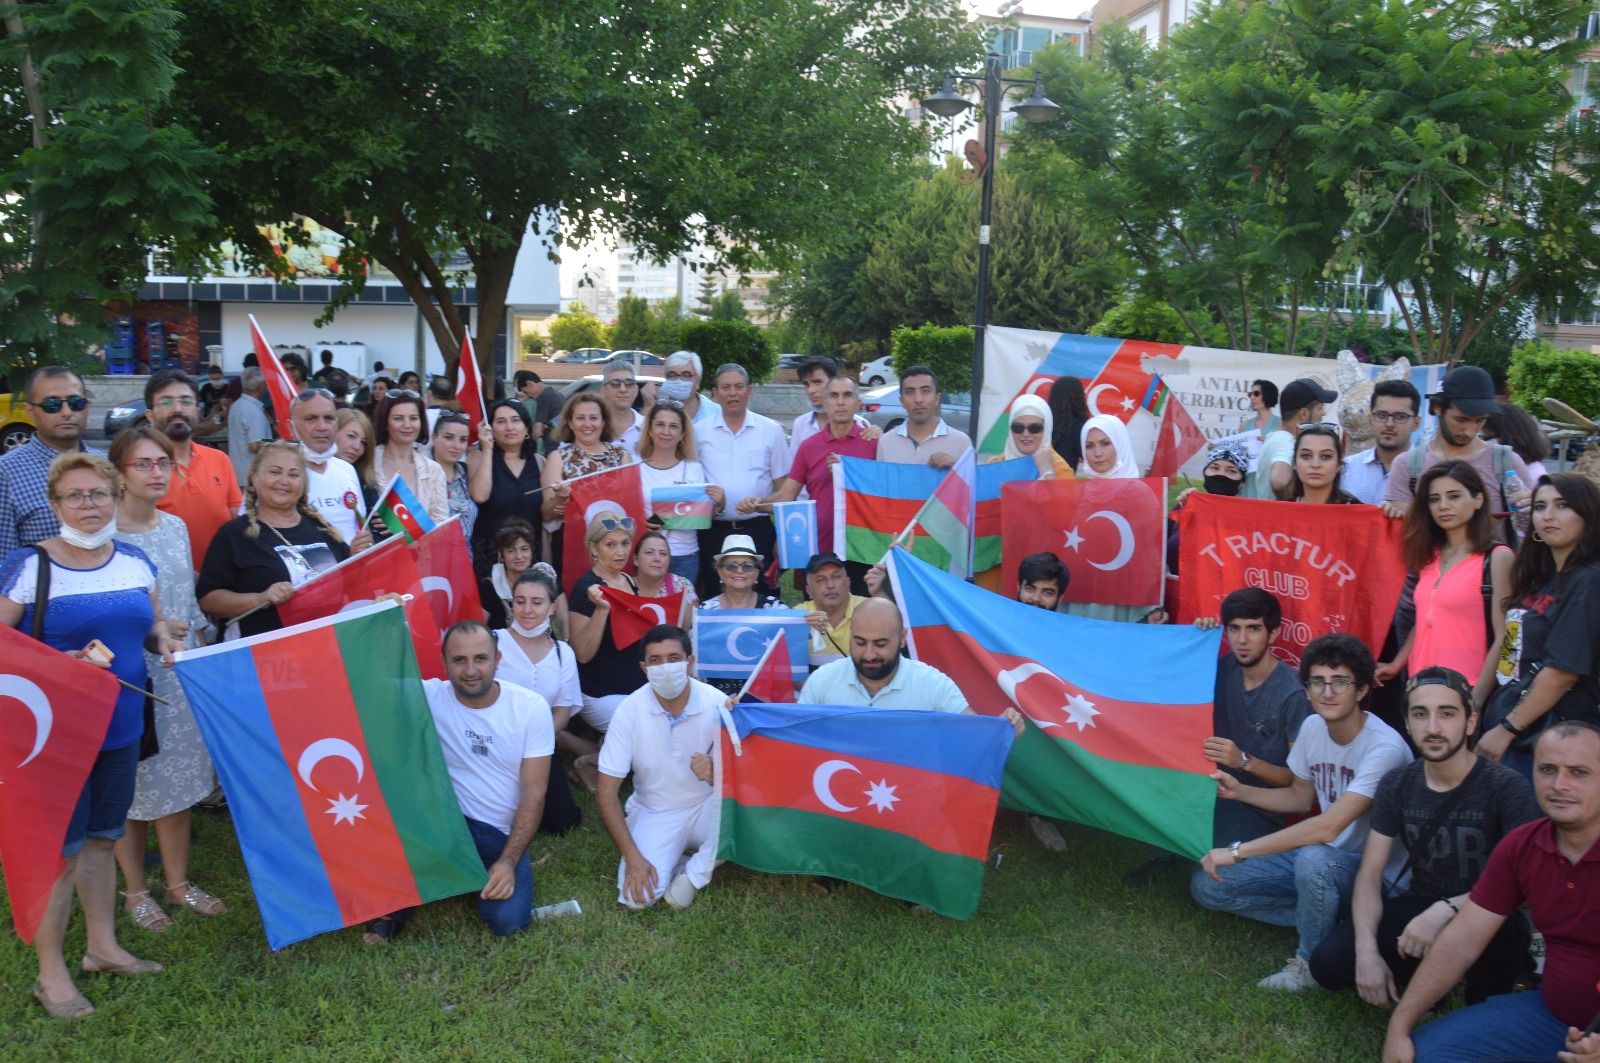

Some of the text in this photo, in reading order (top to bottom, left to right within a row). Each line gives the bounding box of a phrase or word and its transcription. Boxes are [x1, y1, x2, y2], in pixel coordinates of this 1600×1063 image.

[1196, 376, 1250, 393] ANTAL
[1244, 567, 1310, 601] CLUB
[1280, 617, 1313, 647] 70
